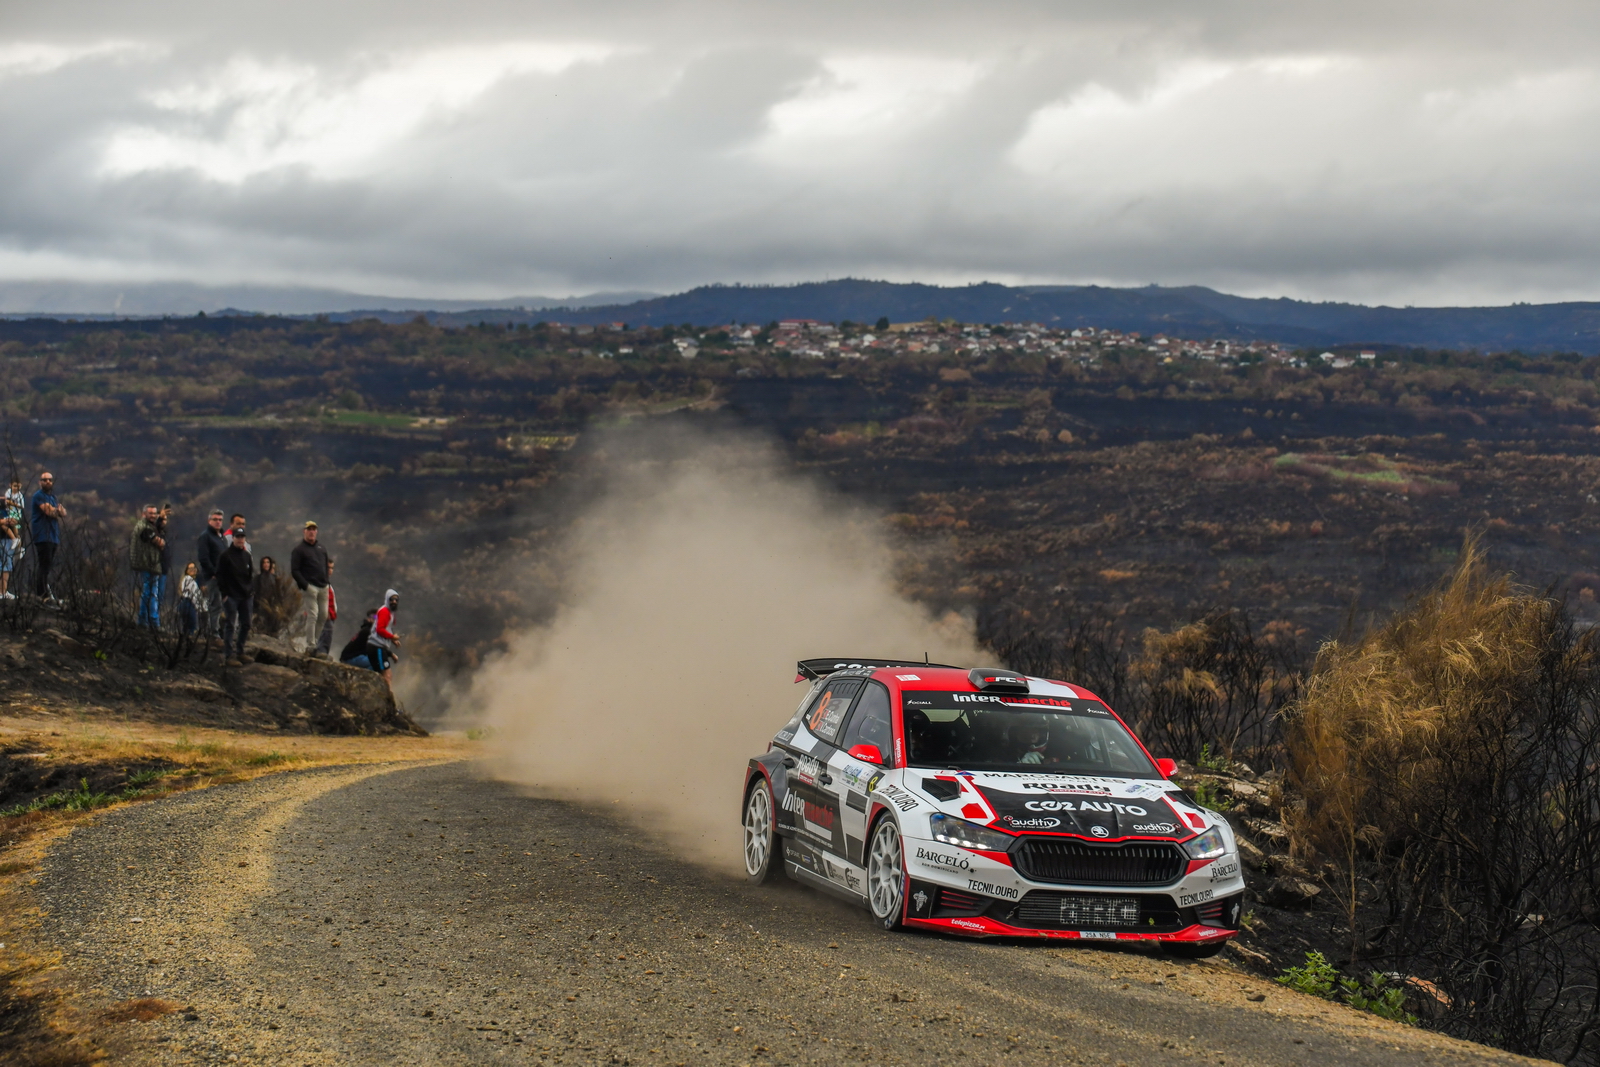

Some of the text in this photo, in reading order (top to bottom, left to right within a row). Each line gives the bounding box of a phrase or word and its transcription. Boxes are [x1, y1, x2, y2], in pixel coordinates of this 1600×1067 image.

[810, 691, 832, 730] 8
[869, 776, 879, 792] 8
[1080, 801, 1147, 817] AUTO
[916, 847, 970, 871] BARCELÓ
[968, 879, 1019, 899] TECNILOURO
